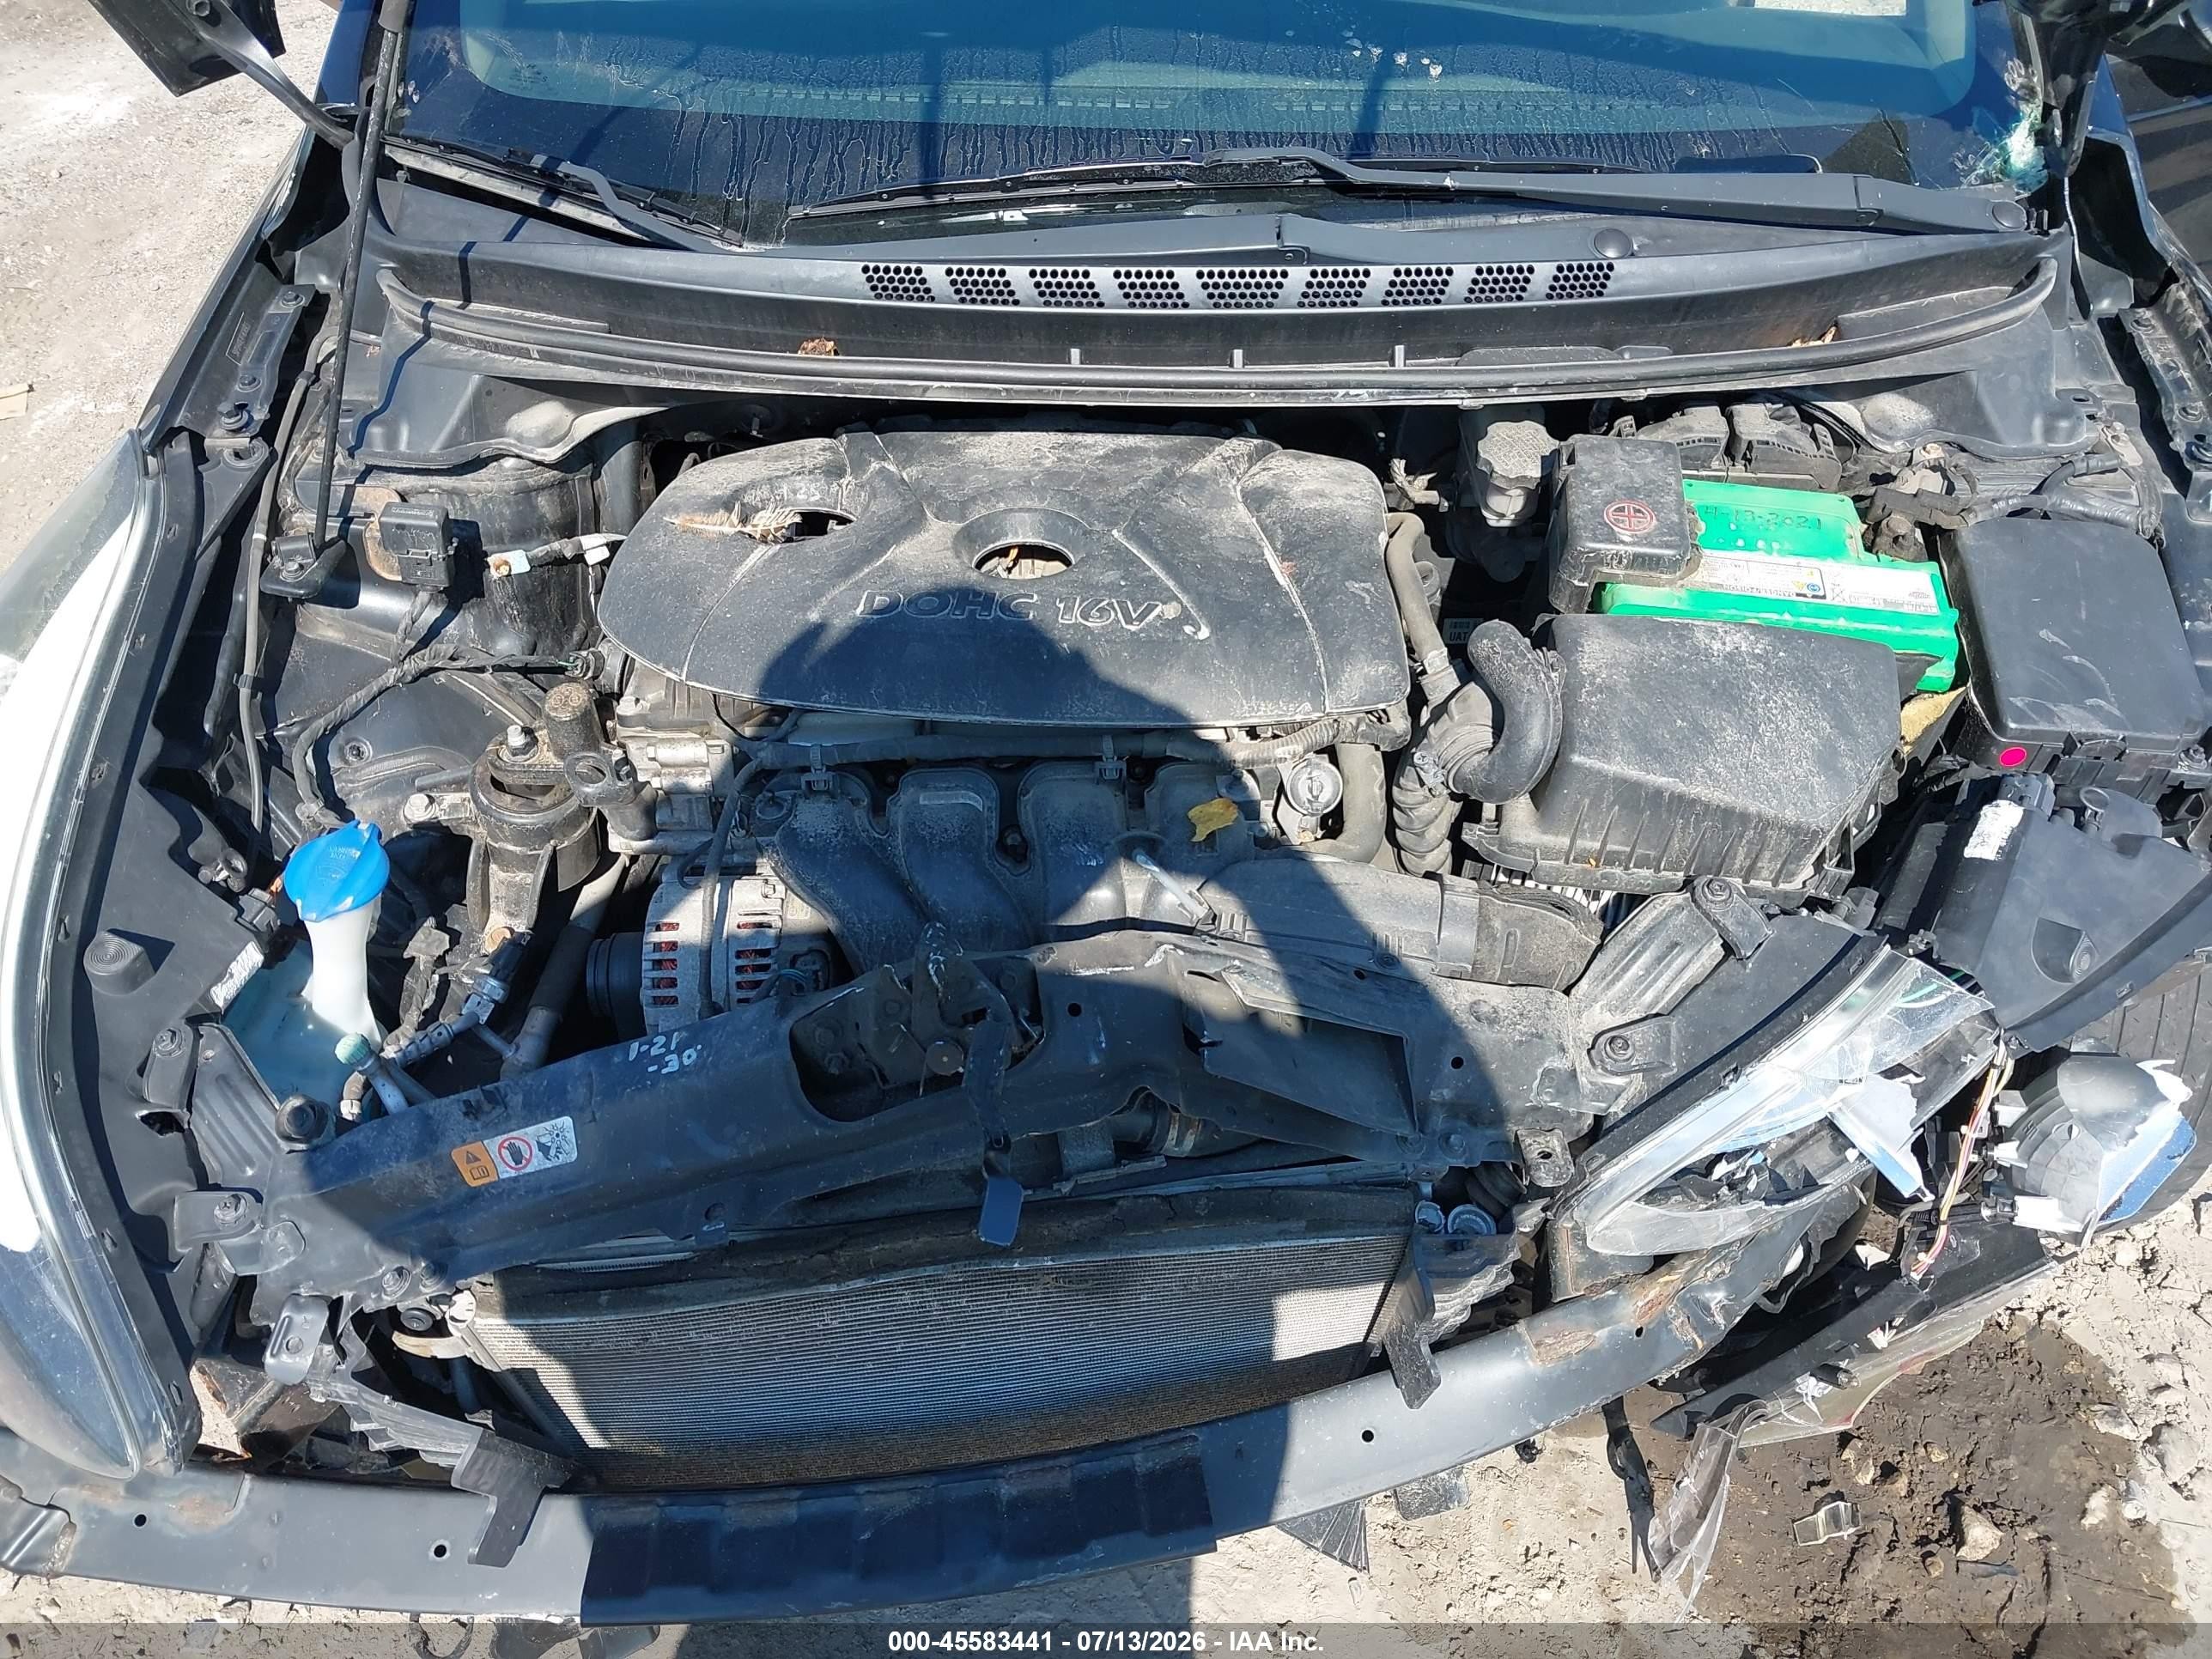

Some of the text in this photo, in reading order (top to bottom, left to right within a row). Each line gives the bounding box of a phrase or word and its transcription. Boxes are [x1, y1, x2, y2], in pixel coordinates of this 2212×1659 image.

[856, 589, 1162, 631] DOHC 16V
[1449, 631, 1468, 641] UAT
